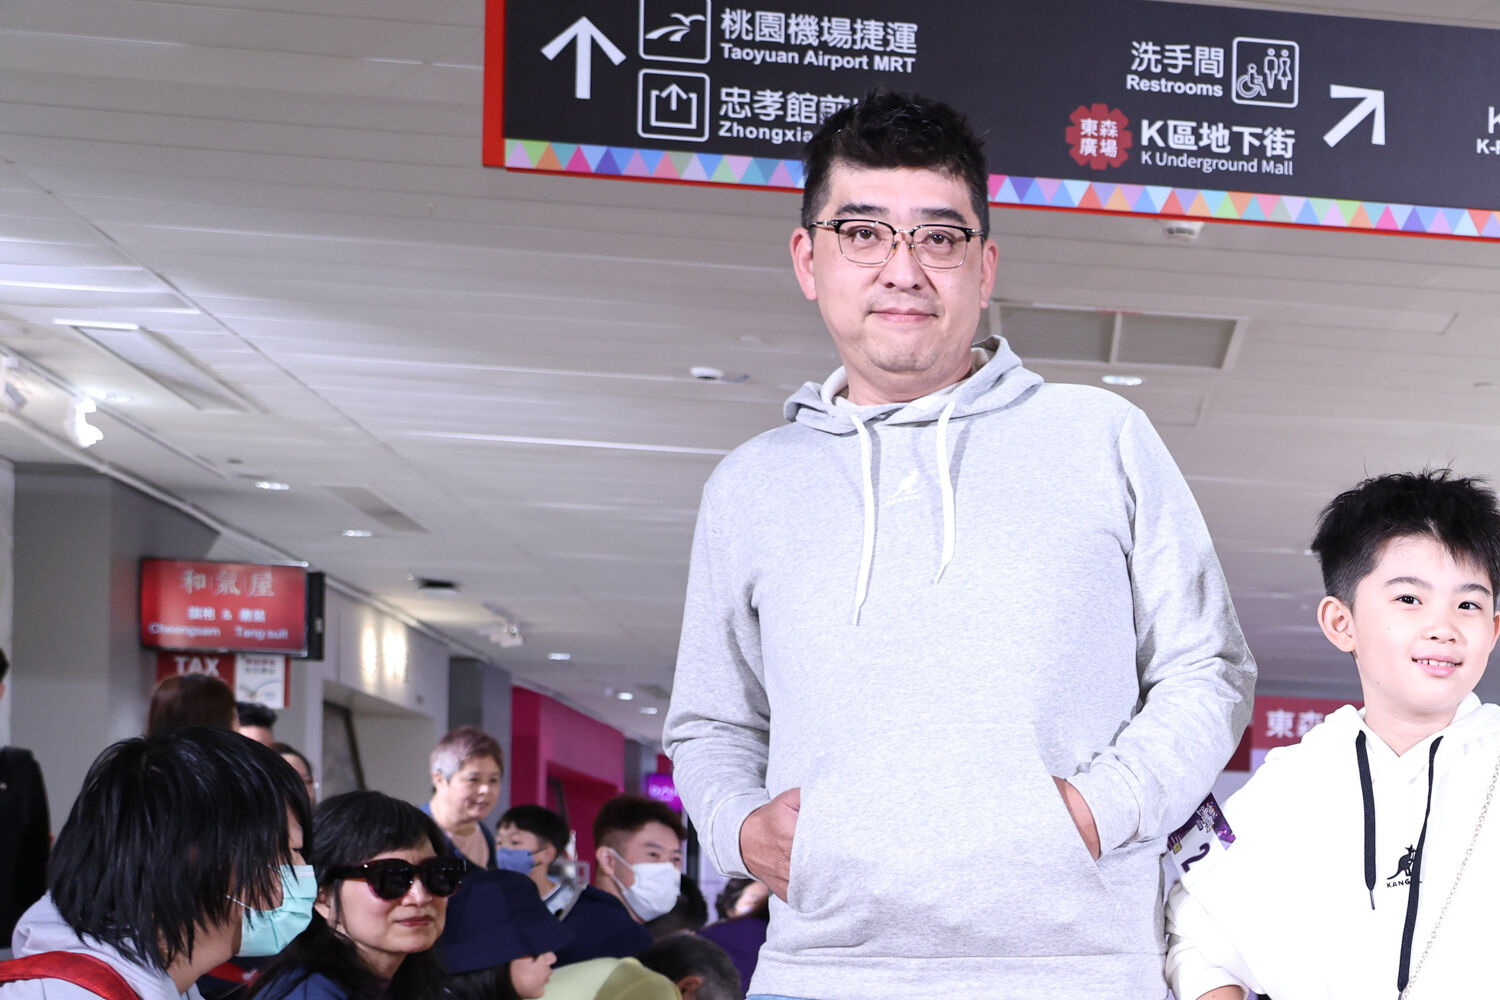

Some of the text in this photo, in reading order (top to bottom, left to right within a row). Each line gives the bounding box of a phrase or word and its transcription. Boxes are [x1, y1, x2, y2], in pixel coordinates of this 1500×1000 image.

[720, 8, 918, 54] 桃園機場捷運
[720, 43, 916, 73] Taoyuan Airport MRT
[1131, 41, 1224, 78] 洗手間
[1126, 74, 1223, 97] Restrooms
[718, 87, 858, 125] 忠孝館前
[1080, 118, 1118, 138] 東森
[1140, 119, 1295, 158] K區地下街
[1079, 138, 1118, 158] 廣場
[1141, 151, 1294, 176] K Underground Mall
[175, 656, 220, 676] TAX
[1181, 842, 1210, 873] 2
[1386, 878, 1422, 888] KANG
